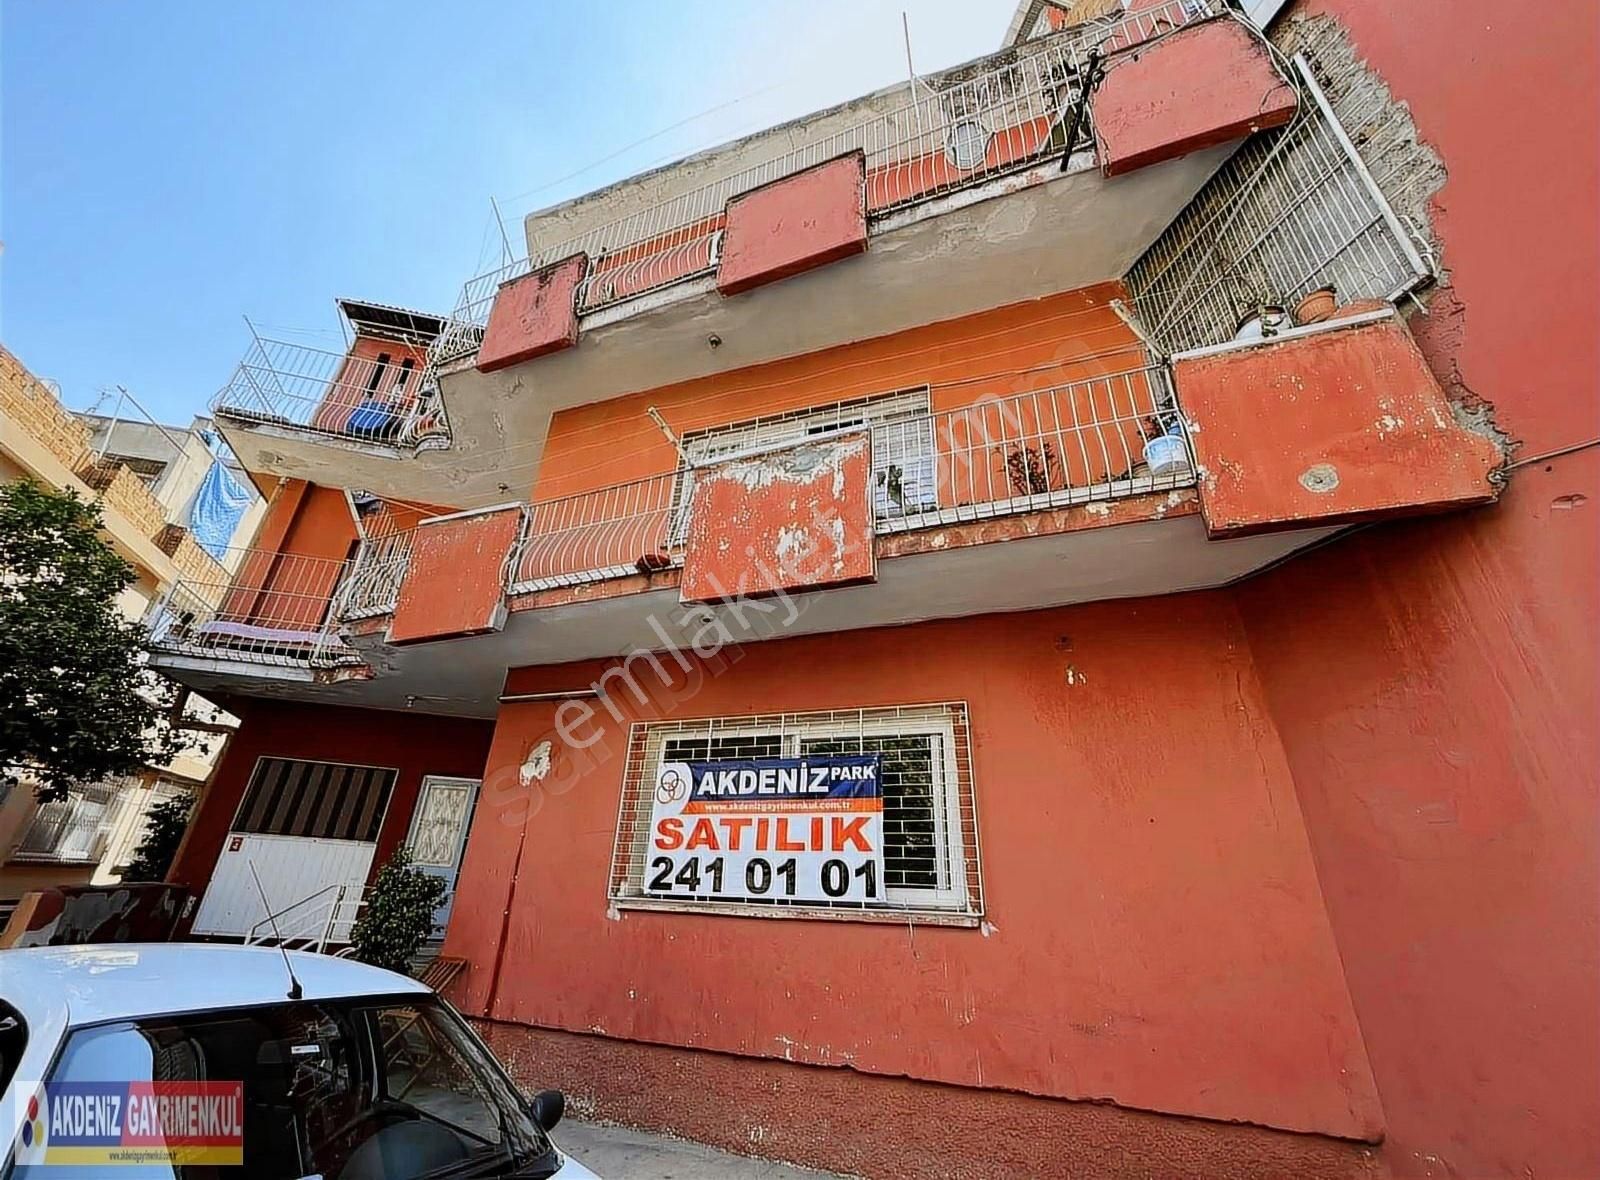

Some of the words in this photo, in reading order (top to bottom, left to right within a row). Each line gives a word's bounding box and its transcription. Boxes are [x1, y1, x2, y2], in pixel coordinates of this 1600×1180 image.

[697, 762, 829, 796] AKDENİZ
[831, 764, 875, 781] PARK
[704, 800, 851, 812] www.akdenizgayrimenkul.com.tr
[655, 817, 873, 852] SATILIK
[648, 856, 724, 893] 241
[745, 858, 797, 895] 01
[820, 859, 877, 898] 01
